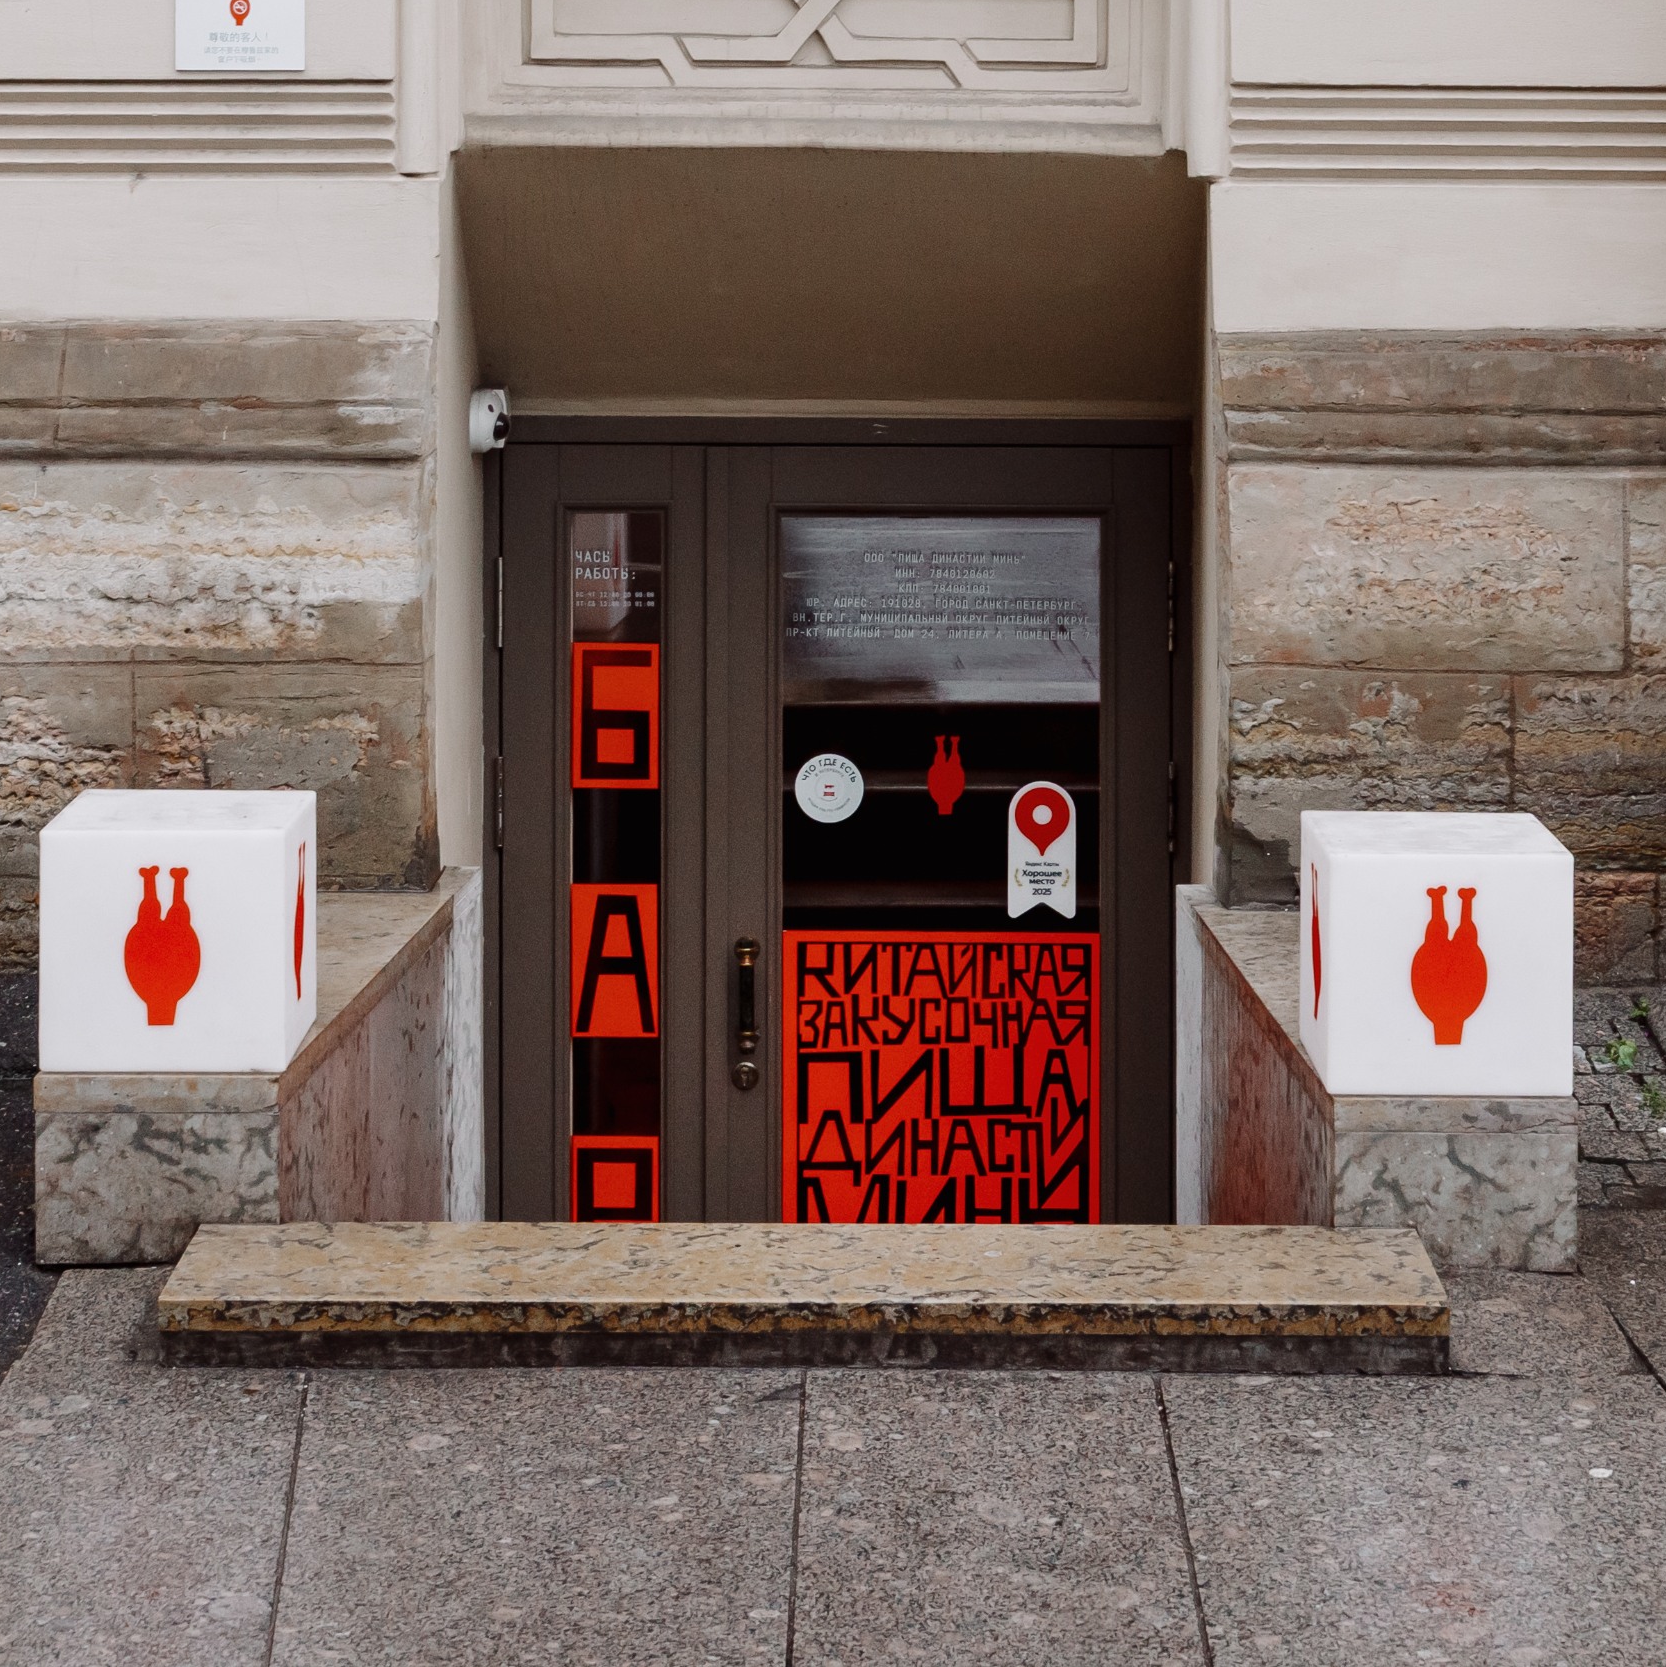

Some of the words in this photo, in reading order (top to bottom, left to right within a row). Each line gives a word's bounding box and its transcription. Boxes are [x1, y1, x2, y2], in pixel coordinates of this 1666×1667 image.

[575, 550, 610, 563] ЧАСЫ
[864, 554, 884, 563] ООО
[932, 554, 986, 564] ДИНАСТИИ
[575, 567, 636, 580] РАБОТЫ:
[895, 568, 921, 578] ИНН:
[930, 569, 995, 579] 7840120602
[898, 584, 924, 593] КПП:
[806, 598, 825, 607] ЮР.
[834, 598, 873, 608] АДРЕС:
[935, 599, 969, 609] ГОРОД
[860, 612, 948, 624] МУНИЦИПАЛЬНЫЙ
[956, 614, 988, 624] ОКРУГ
[1057, 616, 1090, 625] ОКРУГ
[786, 627, 819, 637] ПР-КТ
[894, 629, 914, 639] ДОМ
[949, 630, 988, 639] ЛИТЕРА
[1016, 631, 1076, 641] ПОМЕЩЕНИЕ
[802, 764, 816, 781] ЧТО
[819, 758, 837, 767] ГДЕ
[840, 762, 857, 783] ЕСТЬ
[1022, 869, 1062, 878] Хорошее
[798, 941, 1091, 999] КИТАЙСКАЯ
[799, 994, 1090, 1049] ЗАКУСОЧНАЯ
[798, 1044, 1083, 1124] ПИЩА
